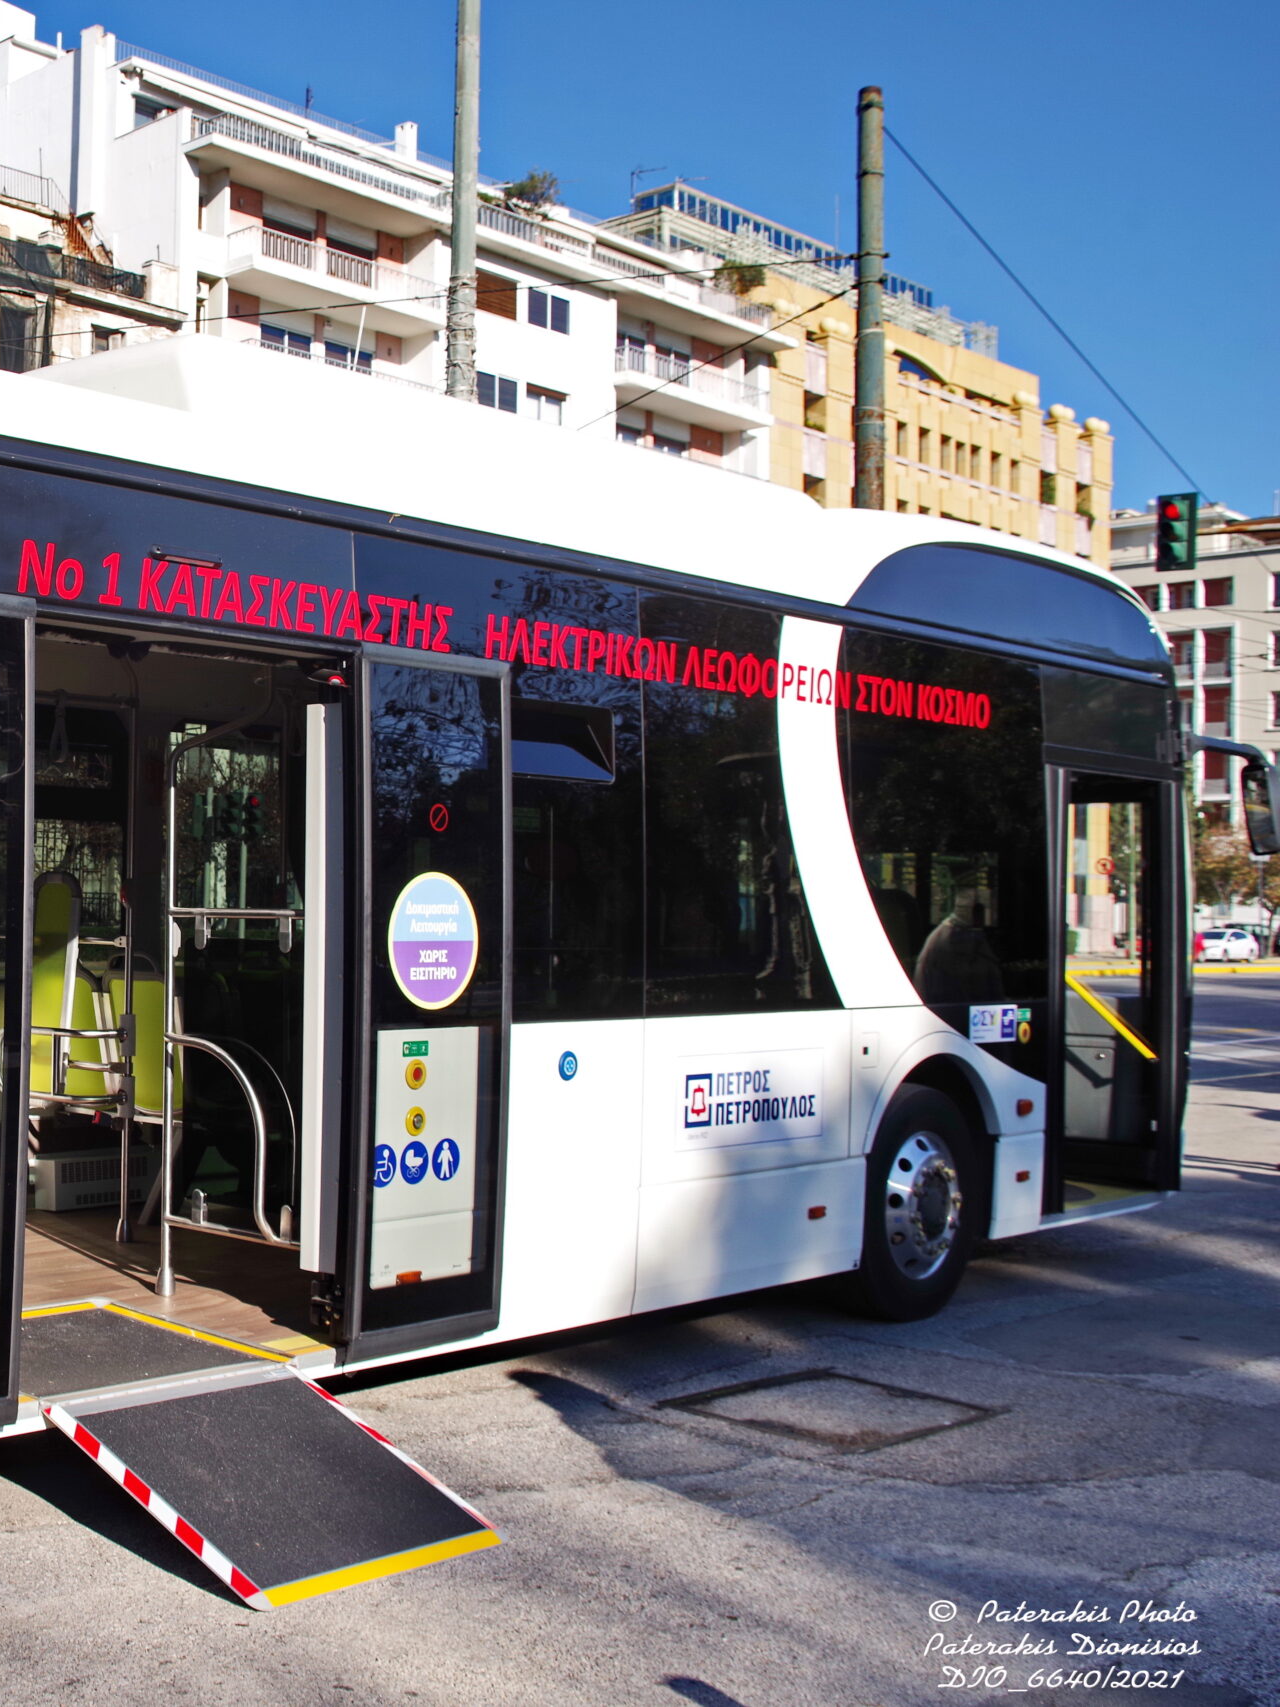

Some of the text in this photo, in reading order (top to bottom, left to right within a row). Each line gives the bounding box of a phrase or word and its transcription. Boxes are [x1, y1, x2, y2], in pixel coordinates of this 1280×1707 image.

[99, 553, 122, 606] 1
[138, 558, 454, 653] ΚΑΤΑΣΚΕΥΑΣΤΗΣ
[485, 614, 676, 683] ΗΛΕΚΤΡΙΚΩΝ
[682, 646, 851, 709] ΛΕΩΦΟΡΕΙΩΝ
[856, 674, 912, 717] ΣΤΟΝ
[918, 685, 990, 729] ΚΟΣΜΟ
[419, 949, 448, 964] ΧΩΡΙΣ
[409, 966, 458, 981] ΕΙΣΙΤΗΡΙΟ
[716, 1070, 771, 1097] ΠΕΤΡΟΣ
[715, 1094, 816, 1127] ΠΕΤΡΟΠΟΥΛΟΣ
